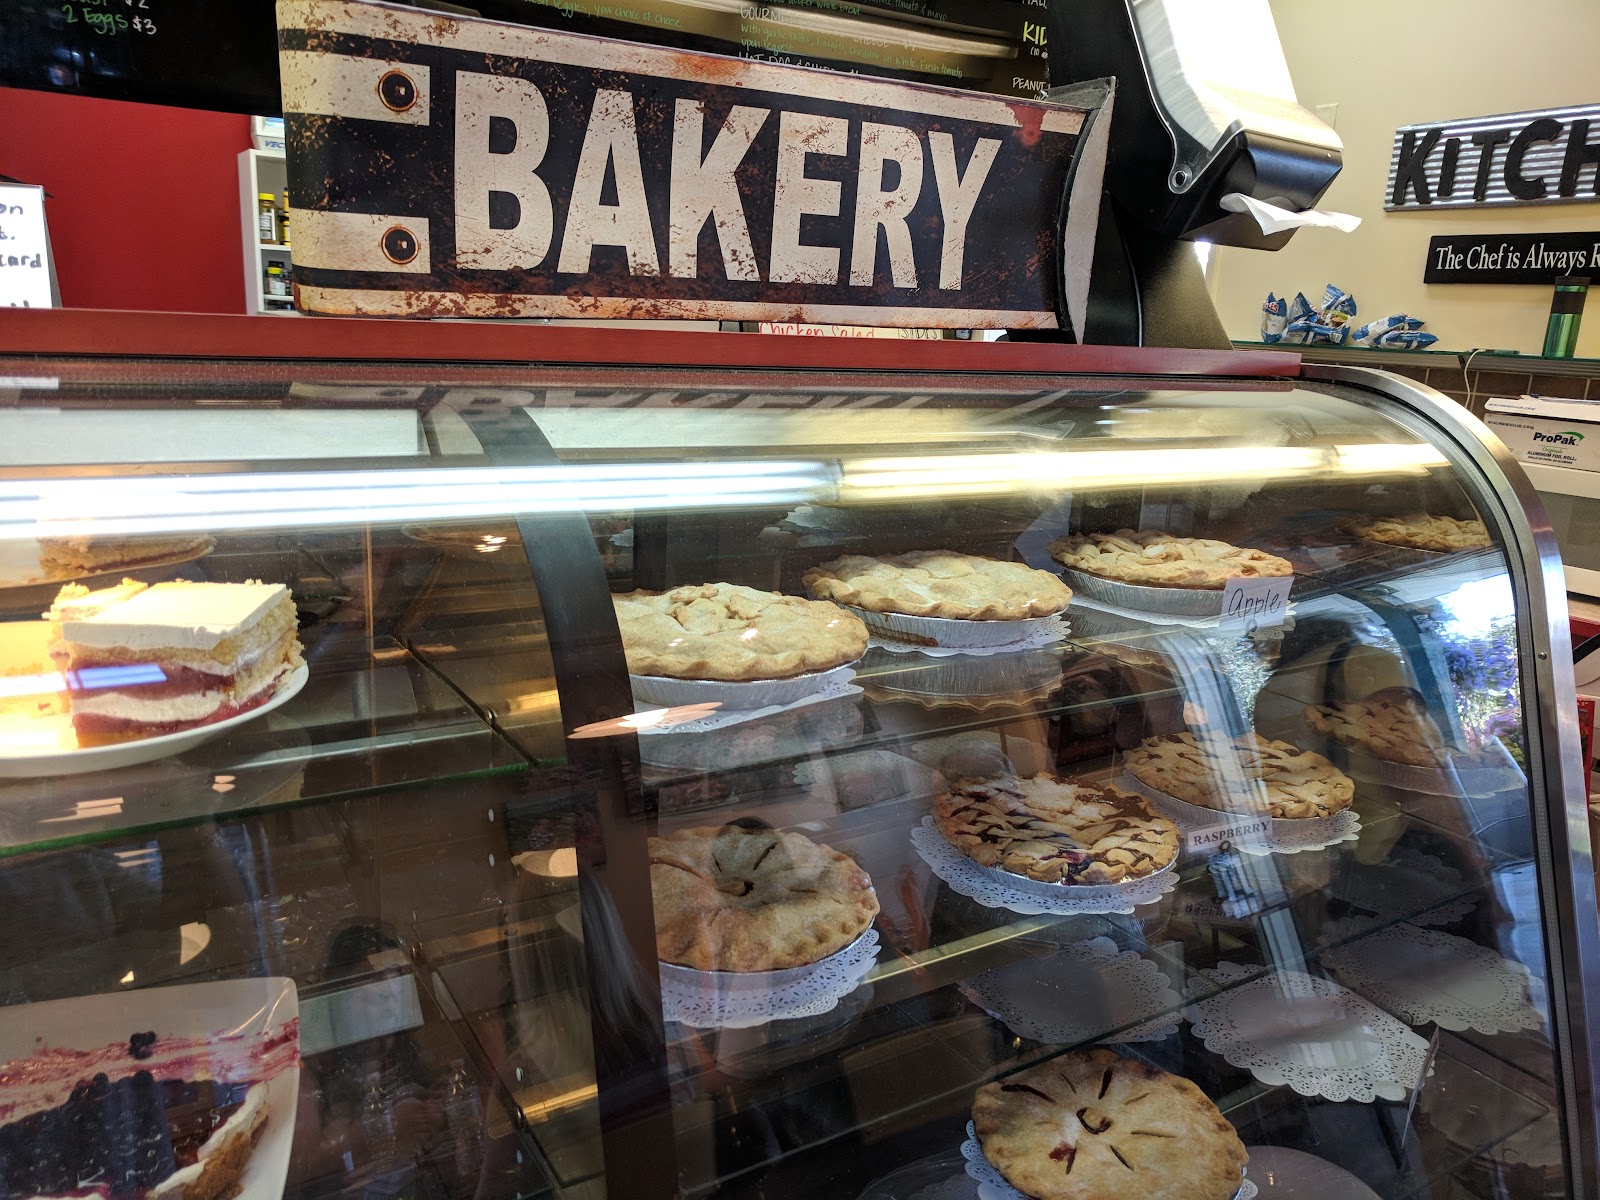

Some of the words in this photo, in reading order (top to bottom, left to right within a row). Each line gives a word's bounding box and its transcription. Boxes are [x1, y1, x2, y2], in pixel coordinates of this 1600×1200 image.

[62, 4, 78, 23] 2
[82, 8, 128, 35] Eggs
[132, 15, 157, 35] $3
[454, 69, 1003, 291] BAKERY
[1436, 245, 1464, 270] The
[1466, 243, 1508, 270] Chef
[1507, 246, 1521, 270] is
[1522, 243, 1587, 277] Always
[1533, 431, 1577, 446] ProPak
[1193, 820, 1270, 846] RASPBERRY
